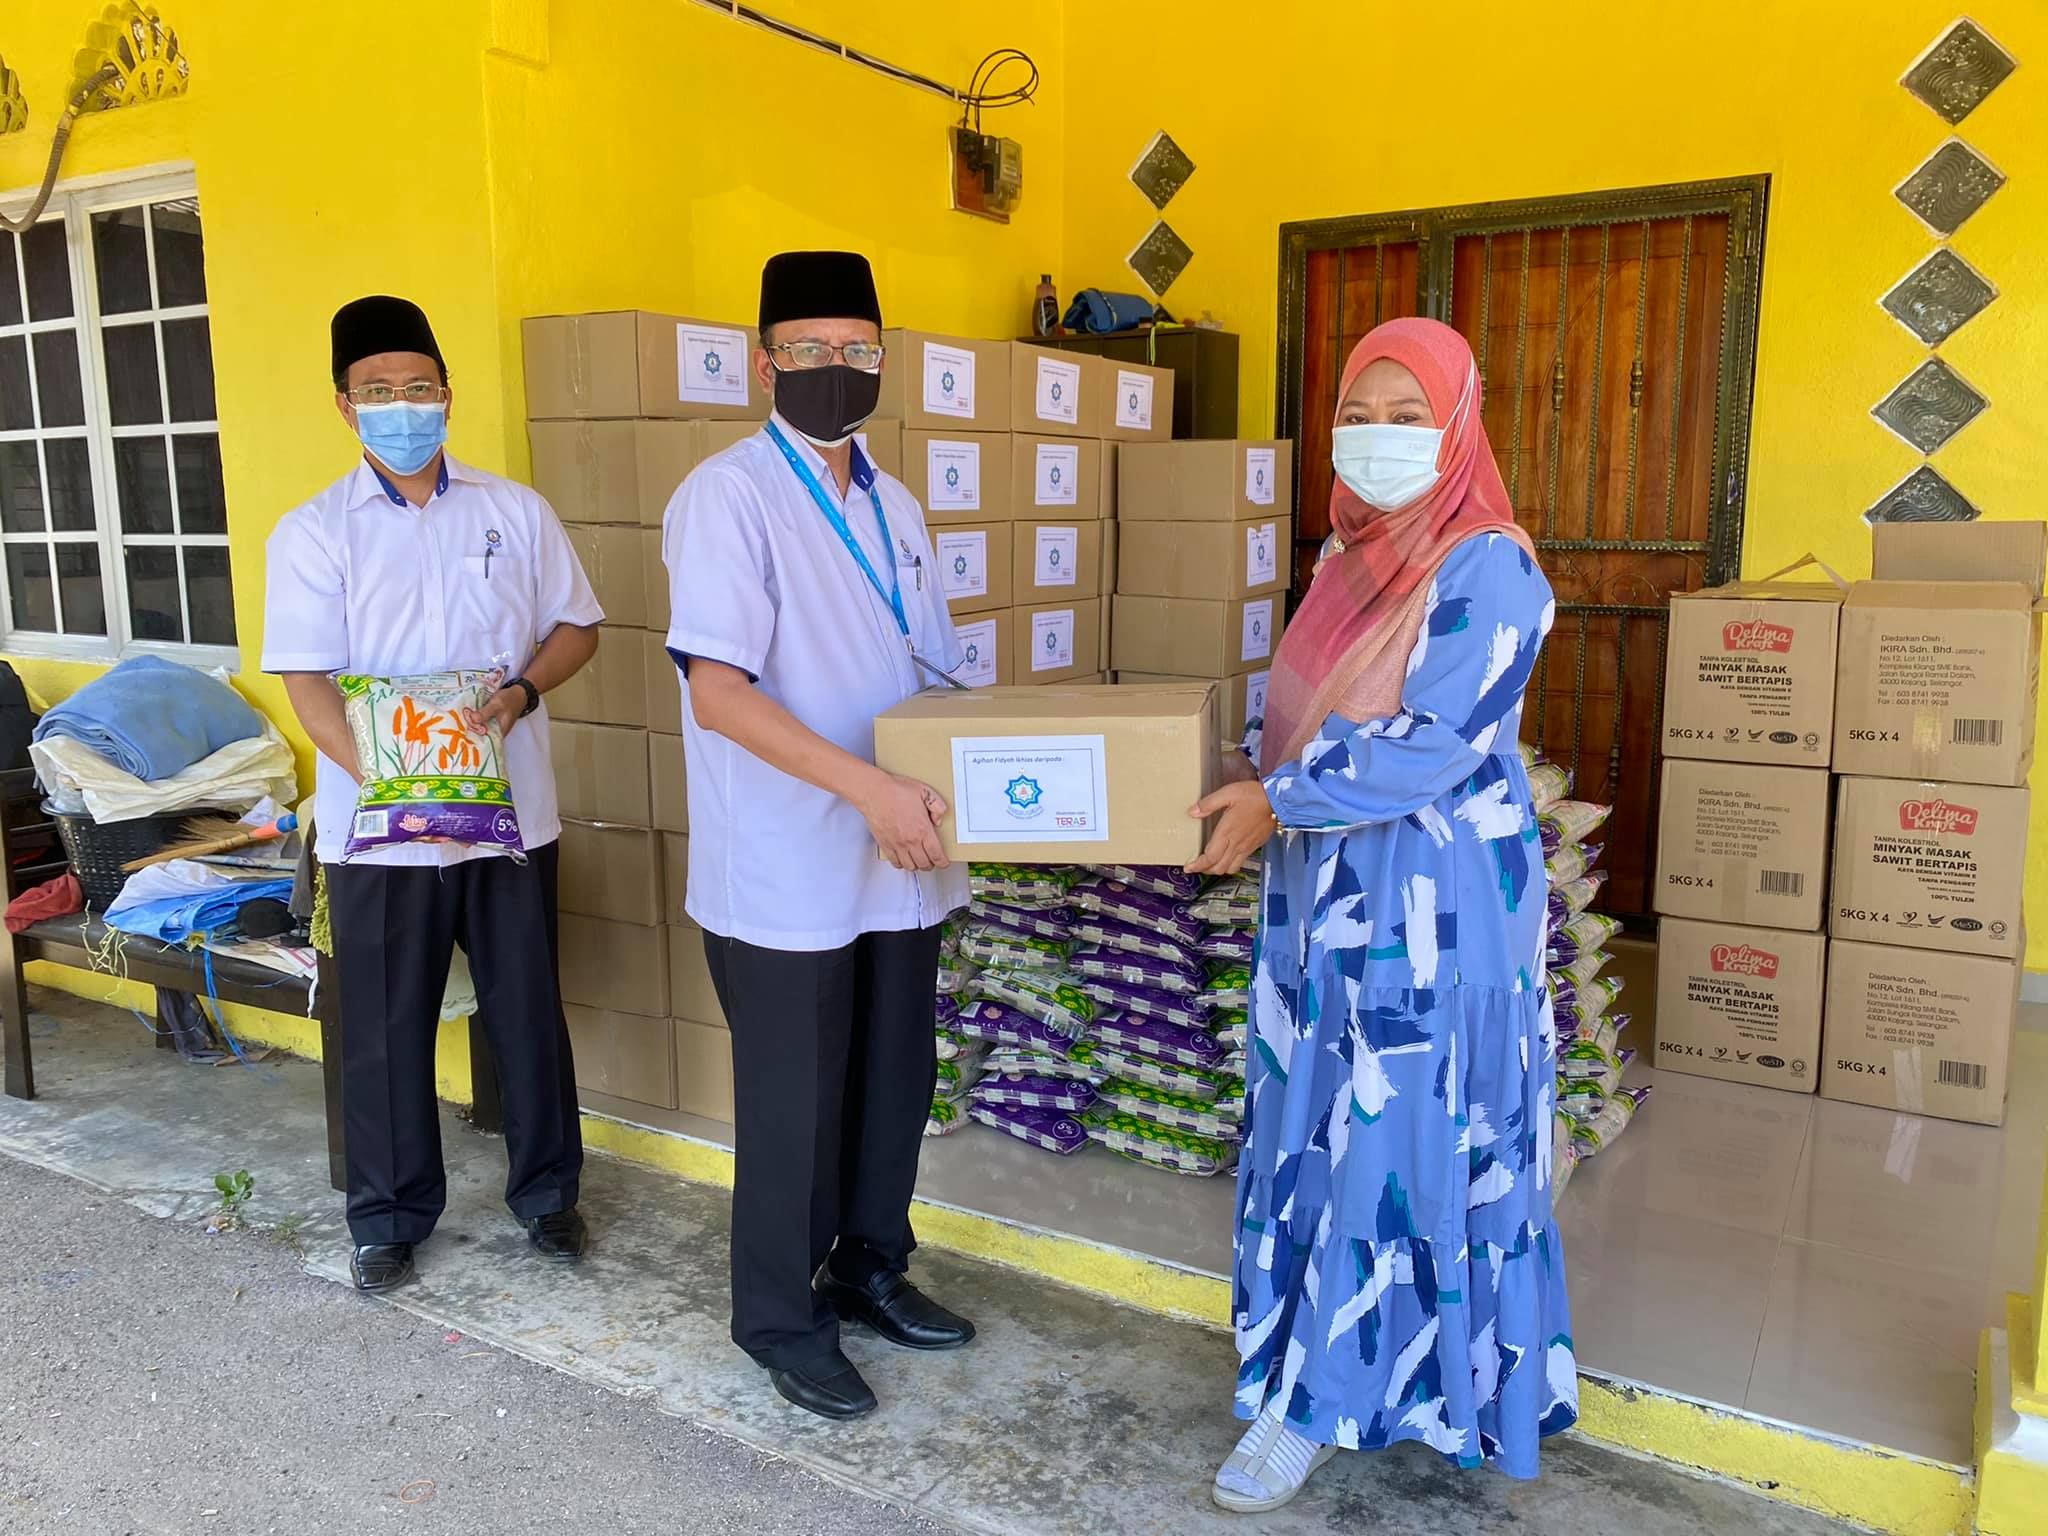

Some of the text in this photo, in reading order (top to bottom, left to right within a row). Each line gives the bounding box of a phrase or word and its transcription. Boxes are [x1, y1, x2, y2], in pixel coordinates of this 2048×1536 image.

[1726, 620, 1790, 643] Delima
[1736, 638, 1774, 650] Kraft
[1880, 645, 1907, 653] IKIRA
[1909, 645, 1930, 654] Sdn.
[1933, 646, 1954, 654] Bhd.
[1699, 663, 1787, 674] MINYAK MASAK
[1698, 674, 1792, 686] SAWIT BERTAPIS
[1669, 728, 1714, 740] 5KG X 4
[1849, 730, 1899, 741] 5KG X 4
[1903, 799, 1974, 825] Delima
[498, 819, 518, 832] 5%
[1056, 817, 1086, 826] TERAS
[1874, 835, 1897, 843] TANPA
[1873, 843, 1972, 859] MINYAK MASAK
[1872, 854, 1977, 872] SAWIT BERTAPIS
[1668, 874, 1713, 888] 5KG X 4
[1840, 908, 1890, 923] 5KG X 4
[1713, 944, 1776, 969] Delima
[1723, 962, 1760, 975] Kraft
[1688, 982, 1774, 1001] MINYAK MASAK
[1868, 983, 1939, 998] IKIRA Sdn. Bhd.
[1687, 993, 1779, 1013] SAWIT BERTAPIS
[1659, 1042, 1703, 1057] 5KG X 4
[1837, 1060, 1886, 1076] 5KG X 4
